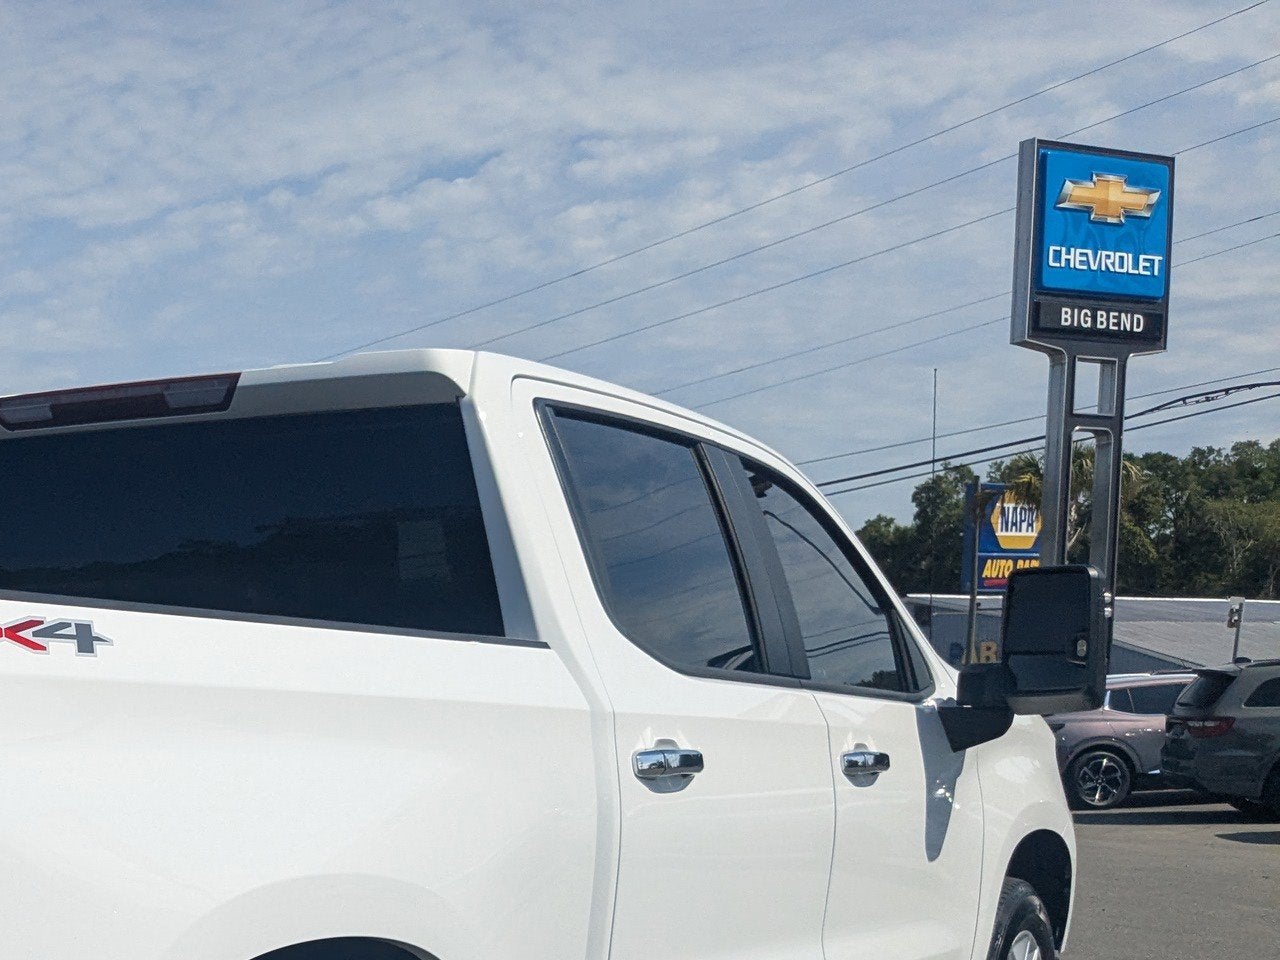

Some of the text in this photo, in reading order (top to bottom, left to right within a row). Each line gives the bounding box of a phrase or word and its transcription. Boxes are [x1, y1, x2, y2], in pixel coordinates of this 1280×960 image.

[1048, 246, 1163, 276] CHEVROLET
[1060, 307, 1145, 333] BIG BEND
[1001, 505, 1037, 533] NAPA
[982, 558, 1014, 578] AUTO
